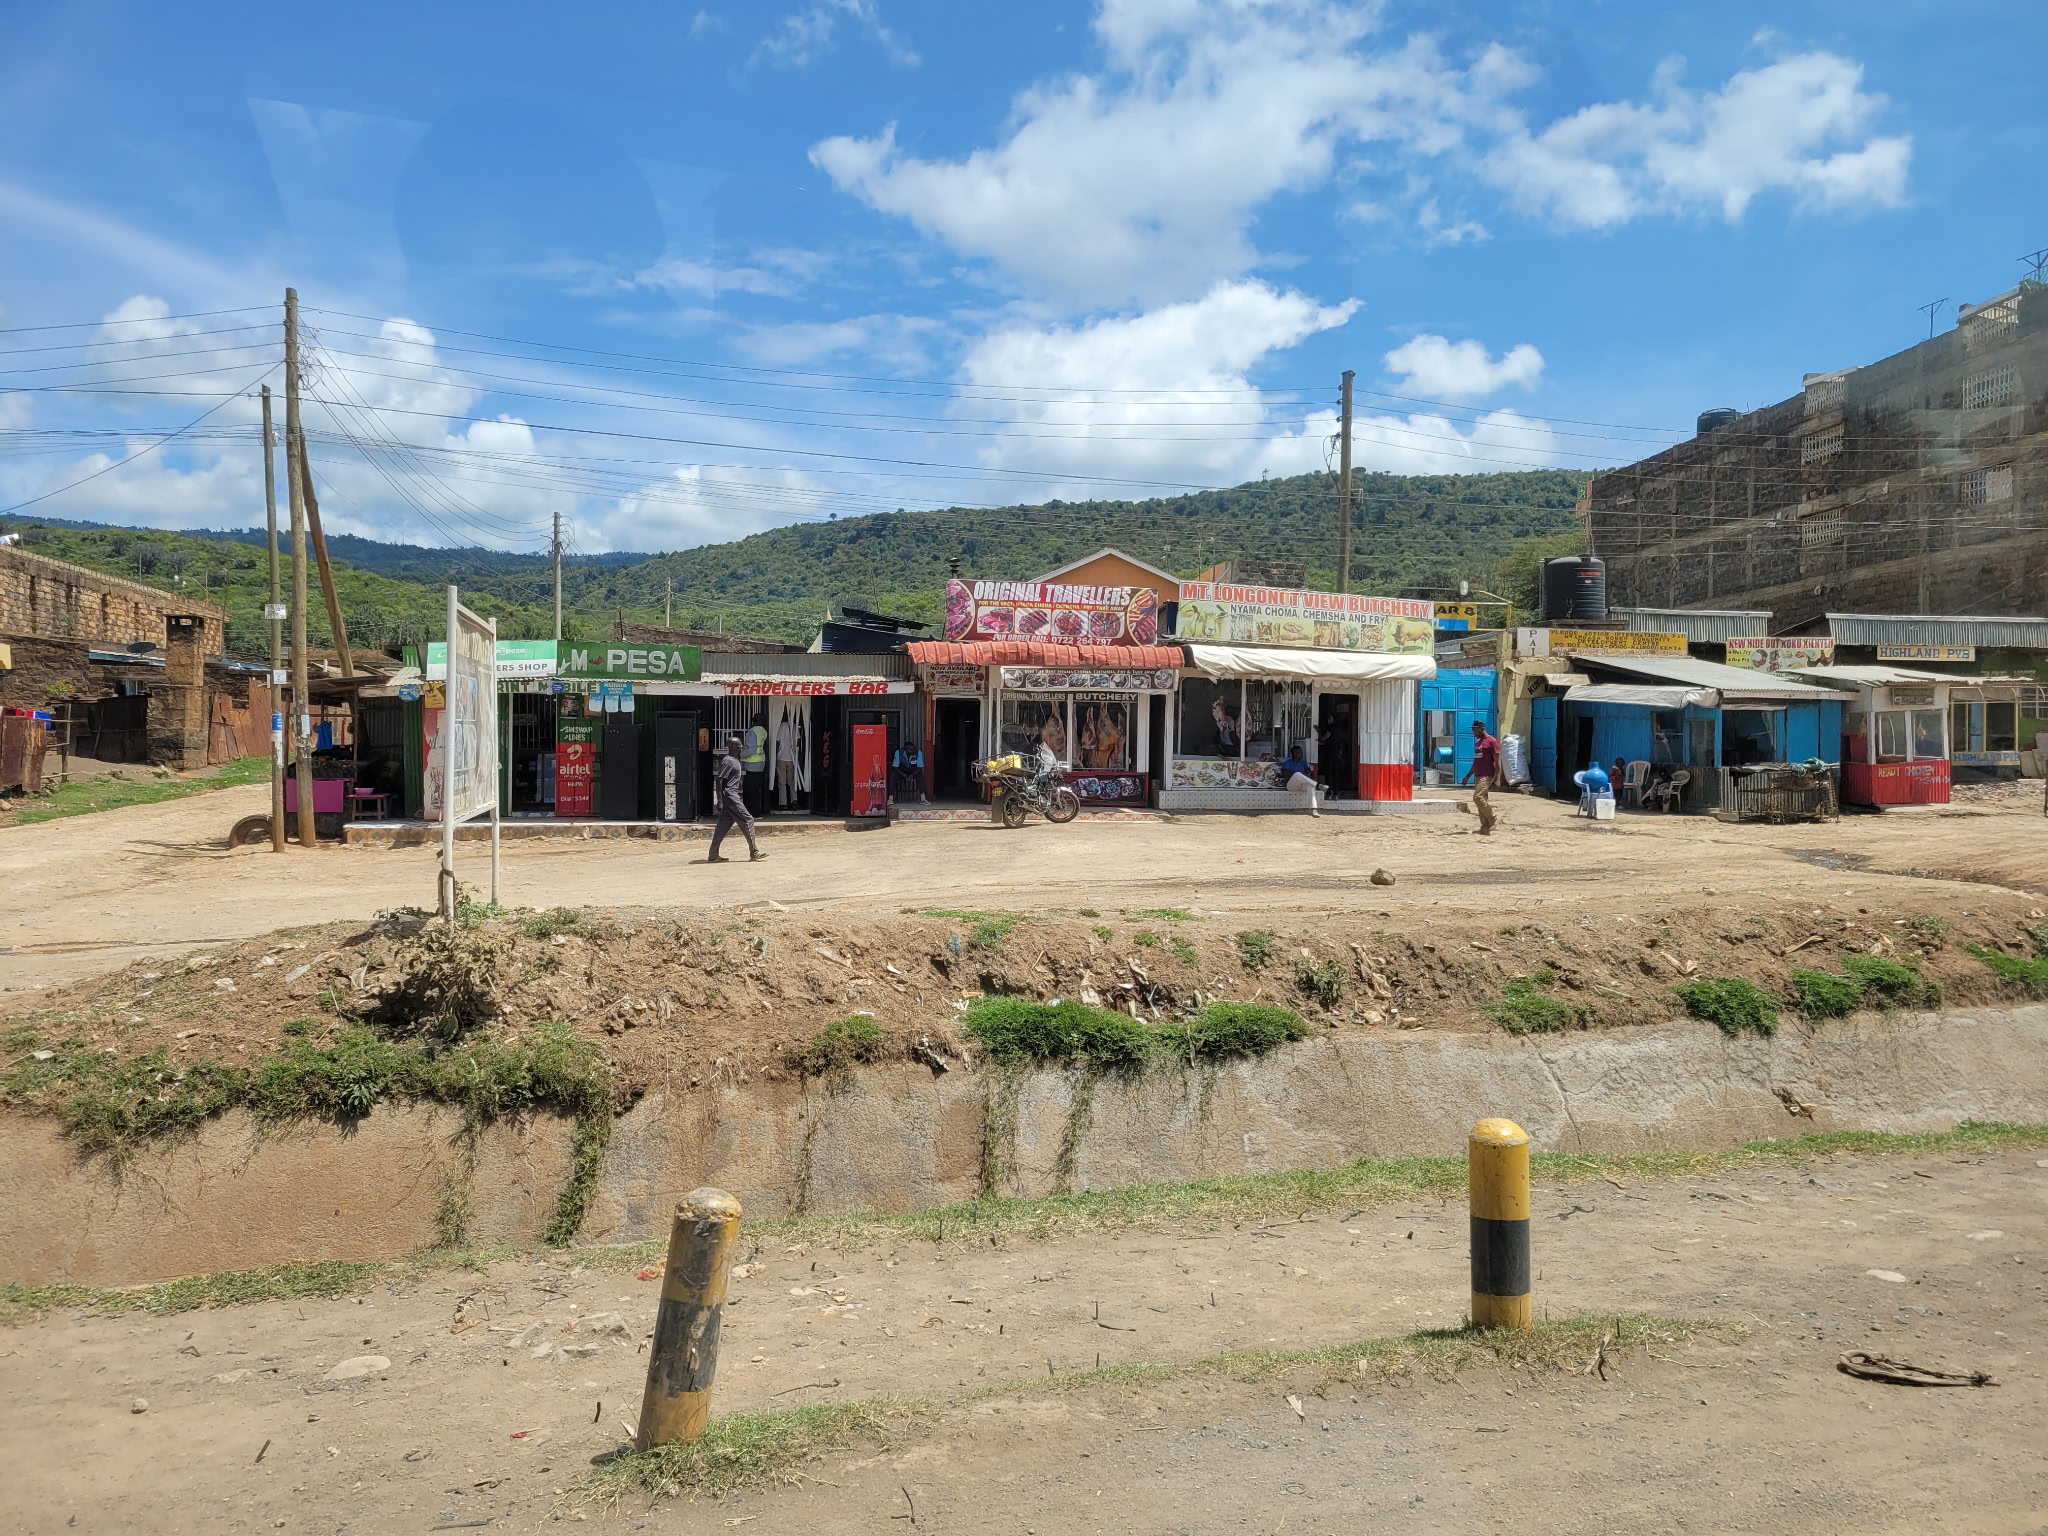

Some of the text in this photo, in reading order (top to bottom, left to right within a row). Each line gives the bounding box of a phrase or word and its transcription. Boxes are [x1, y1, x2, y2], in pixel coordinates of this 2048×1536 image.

[973, 582, 1131, 606] ORIGINAL TRAVELLERS
[1182, 583, 1430, 618] MT. LONGONOT VIEW BUTCHERY
[1230, 604, 1385, 625] NYAMA CHOMA, CHEMSHA AND FRY
[1434, 605, 1460, 616] AR
[993, 633, 1006, 641] FOR
[1007, 634, 1031, 642] ORDER
[1052, 636, 1073, 645] 0722
[1077, 637, 1093, 646] 264
[1729, 639, 1745, 649] NEW
[1747, 639, 1764, 649] HIDE
[1766, 639, 1779, 649] OUT
[1781, 639, 1802, 649] KUKU
[1880, 647, 1940, 659] HIGHLAND
[518, 663, 548, 671] SHOP
[538, 681, 598, 693] MBILE
[726, 682, 889, 696] TRAVELLERS BAR
[1002, 692, 1138, 701] ORIGINAL TRAVELLERS BUTCHERY
[560, 763, 591, 775] airtel
[1878, 767, 1900, 777] READY
